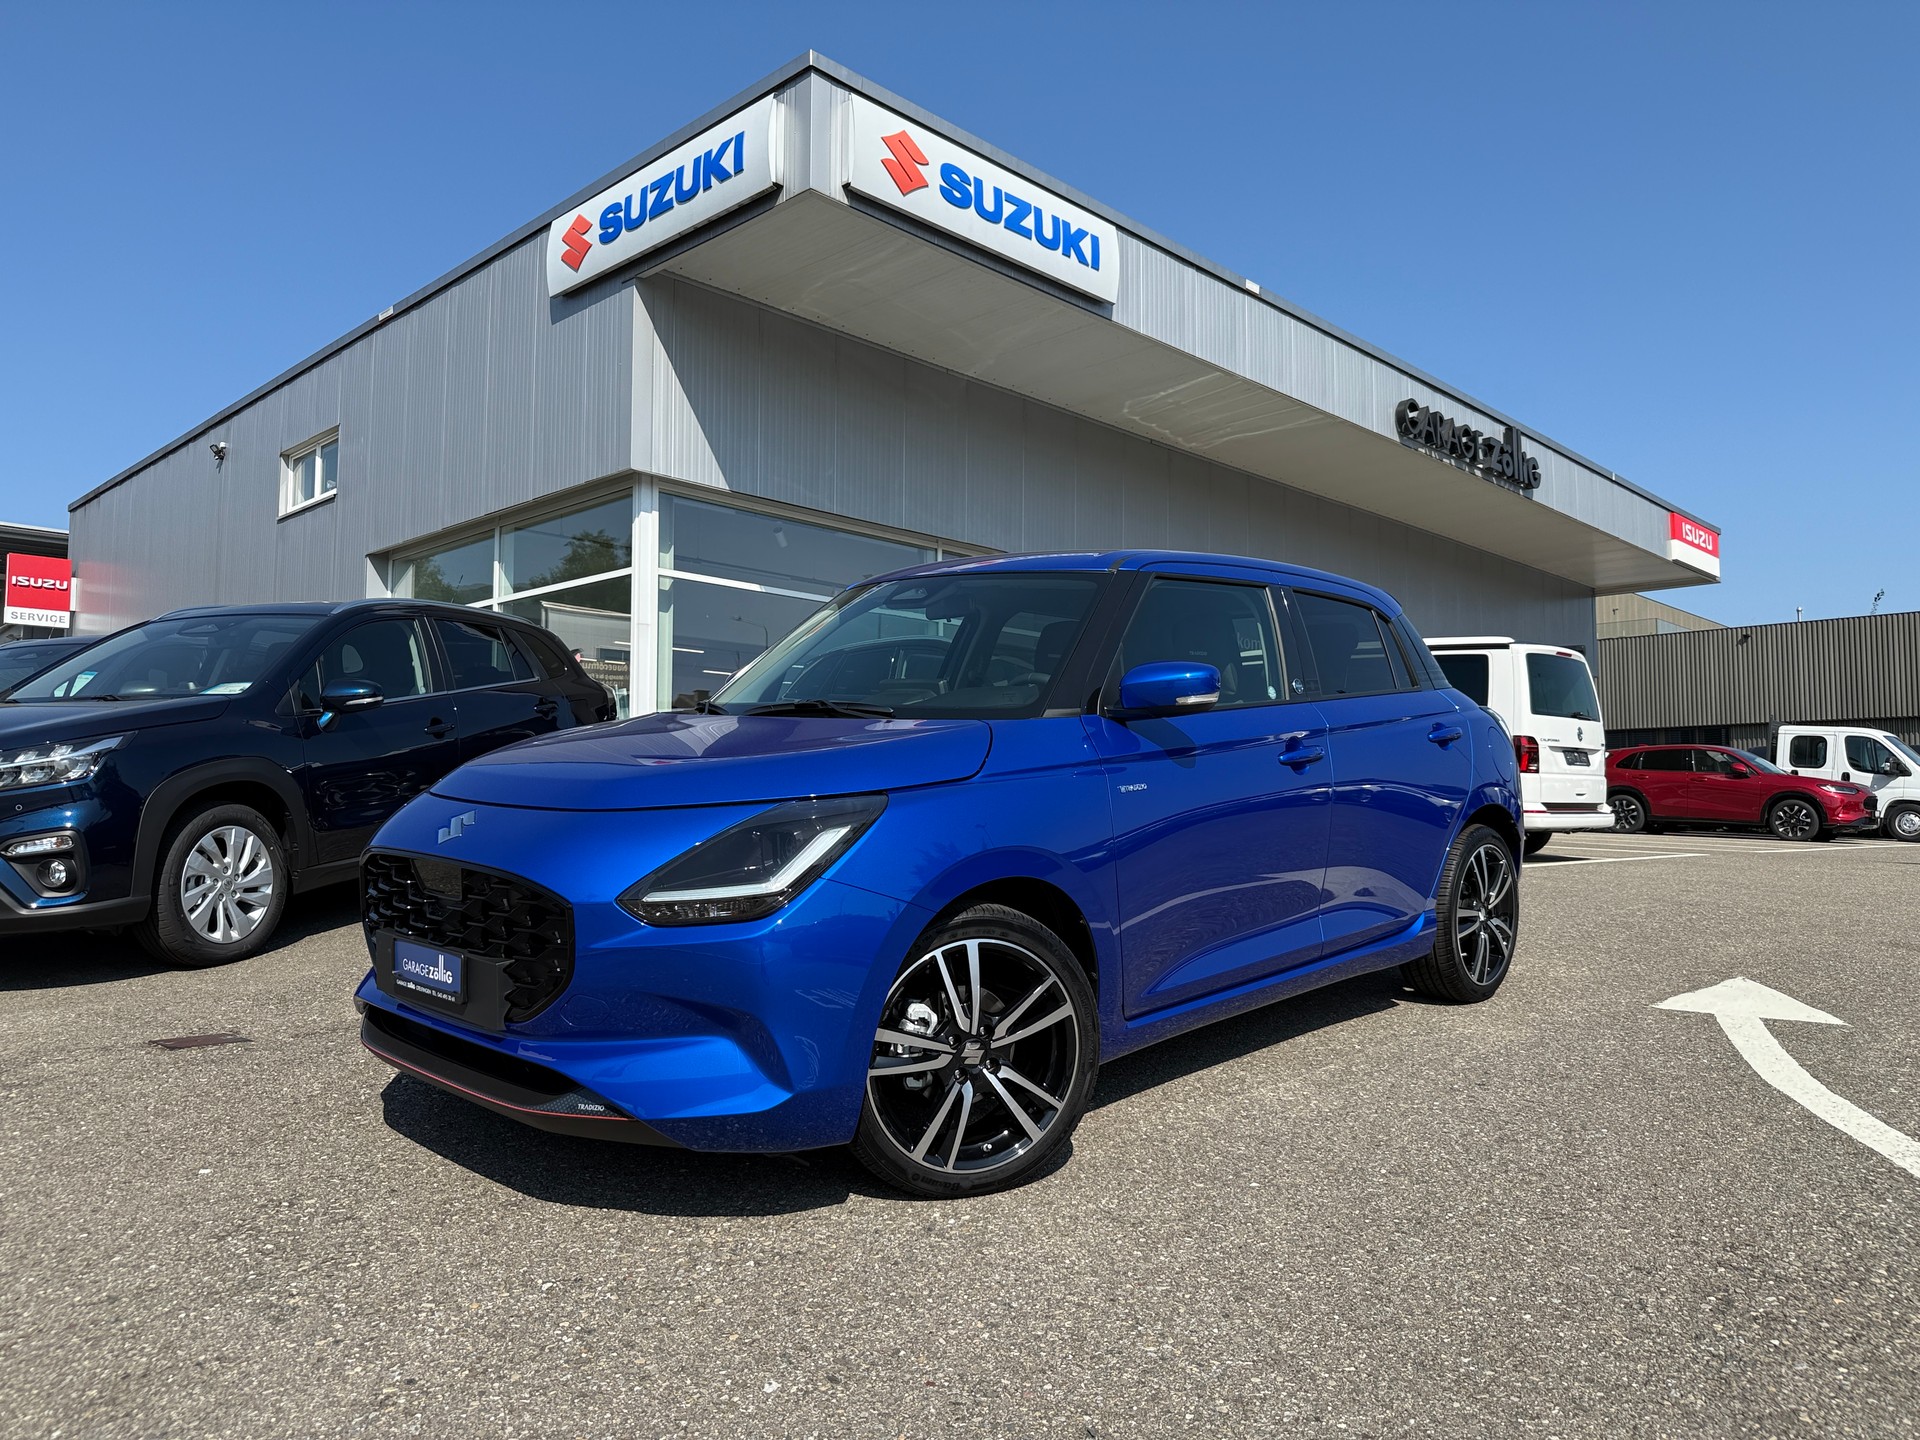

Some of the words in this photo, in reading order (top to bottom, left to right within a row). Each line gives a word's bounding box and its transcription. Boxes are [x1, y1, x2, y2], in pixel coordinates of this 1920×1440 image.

[599, 131, 745, 244] SUZUKI
[939, 163, 1100, 272] SUZUKI
[1682, 522, 1713, 551] ISUZU
[11, 575, 68, 590] ISUZU
[11, 611, 66, 624] SERVICE
[578, 1104, 605, 1112] TRADIZIO
